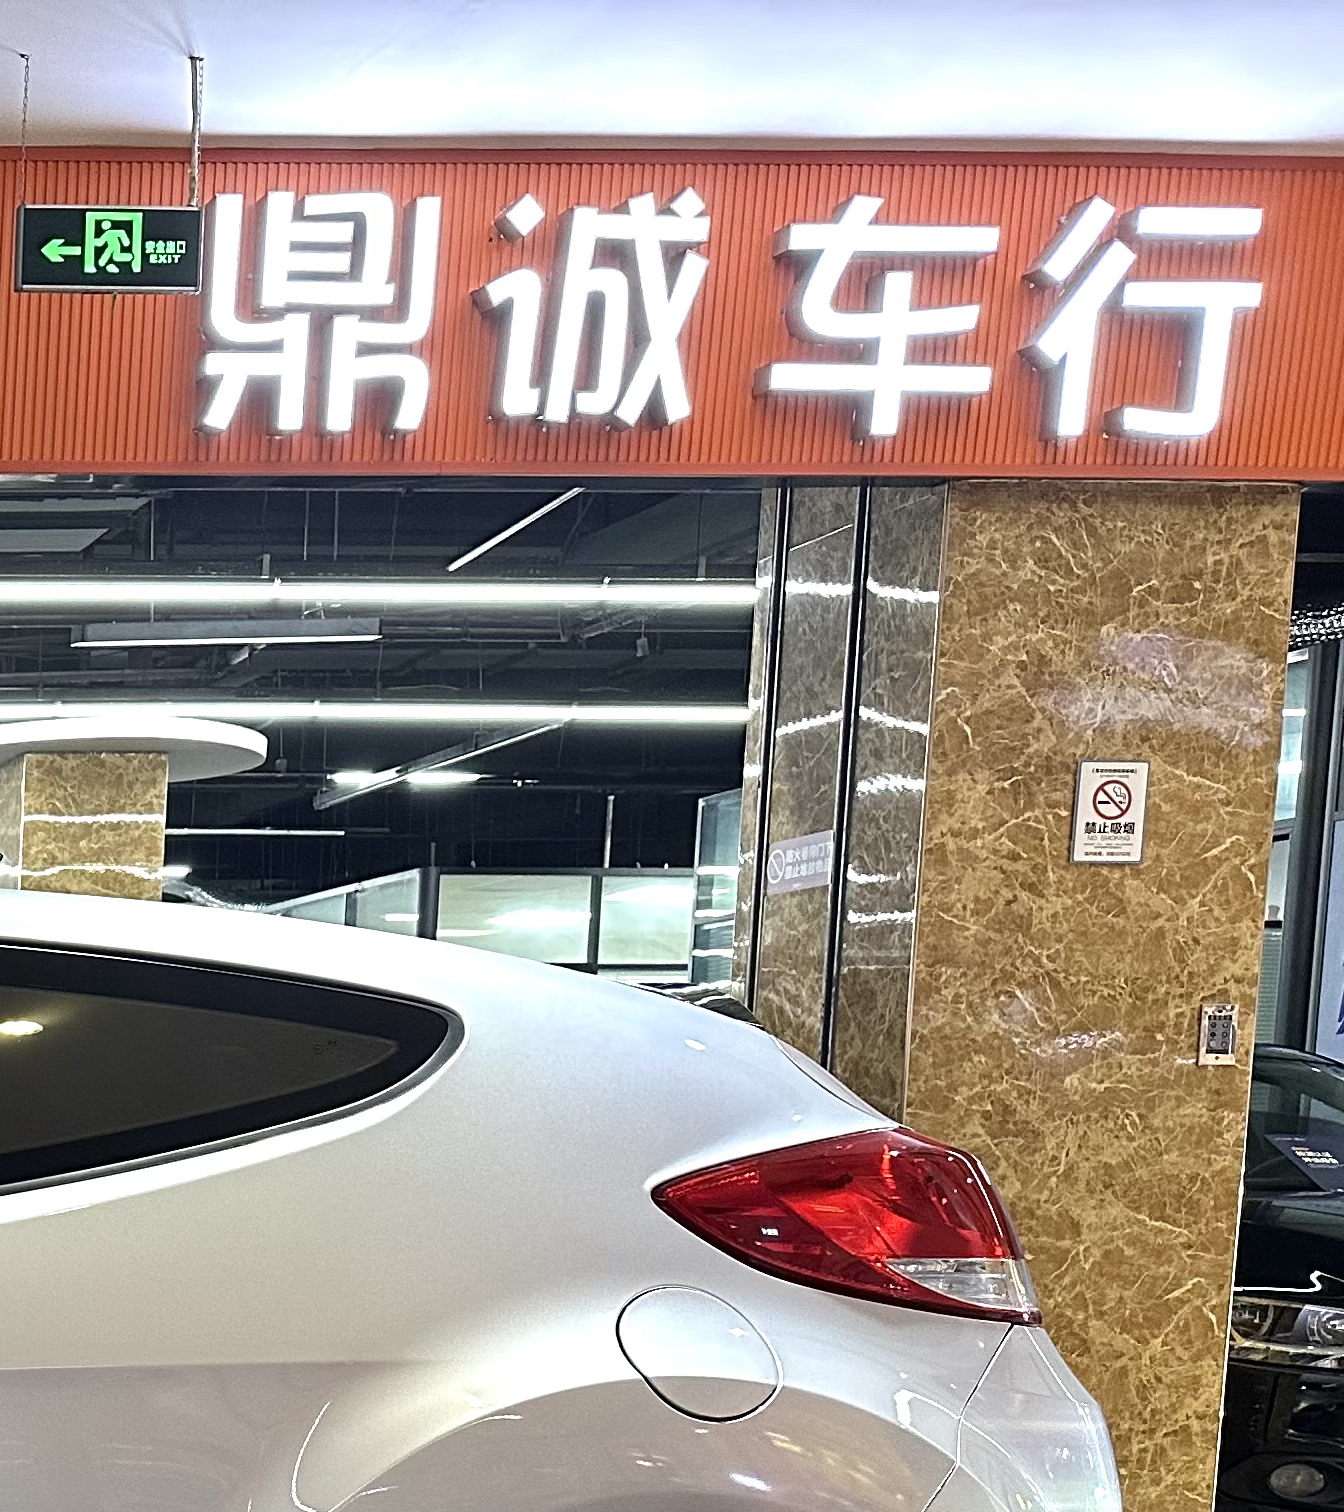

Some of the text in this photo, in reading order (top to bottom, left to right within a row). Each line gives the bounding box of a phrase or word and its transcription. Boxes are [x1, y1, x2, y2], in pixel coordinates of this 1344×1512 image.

[145, 240, 186, 254] 安全出口
[149, 254, 181, 263] EXIT
[200, 186, 1264, 442] 鼎诚车行
[1084, 822, 1135, 835] 禁止吸烟
